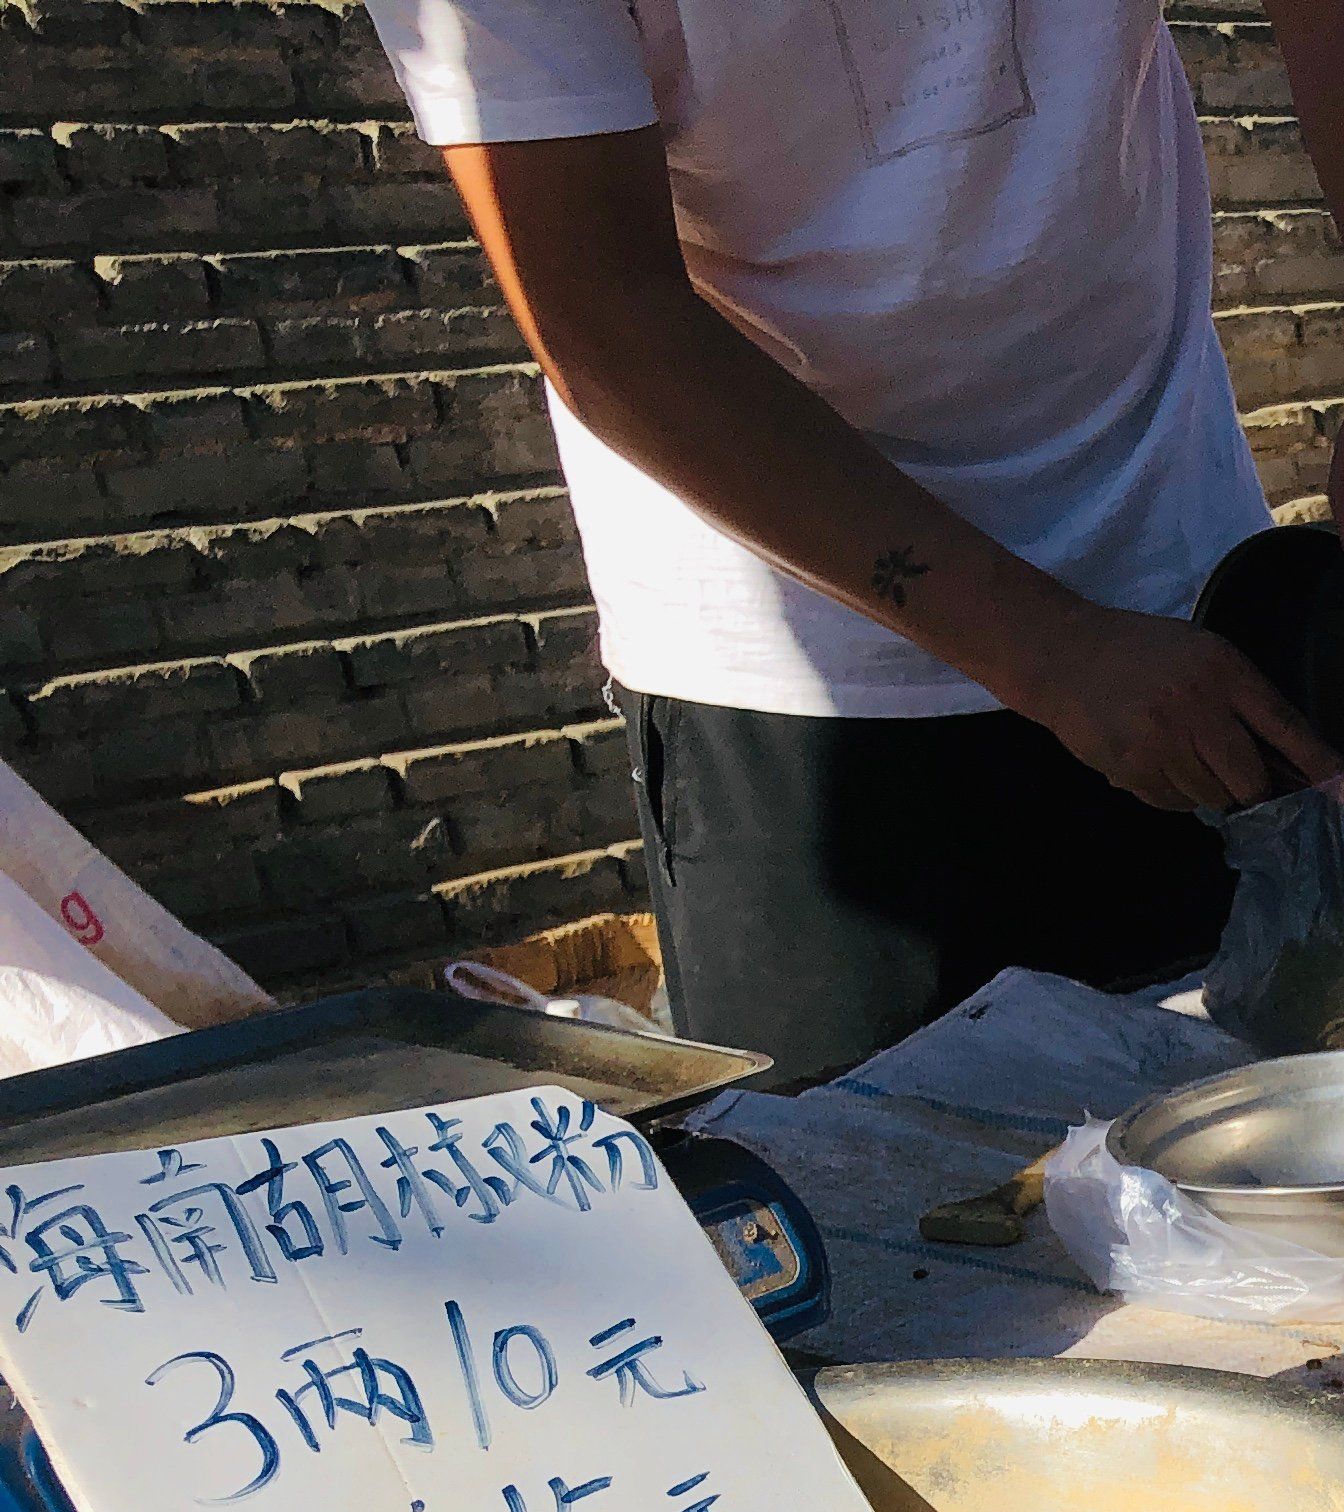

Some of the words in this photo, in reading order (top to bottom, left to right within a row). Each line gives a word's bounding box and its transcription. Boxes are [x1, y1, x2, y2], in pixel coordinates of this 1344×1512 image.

[0, 1097, 658, 1332] 海南胡椒粉
